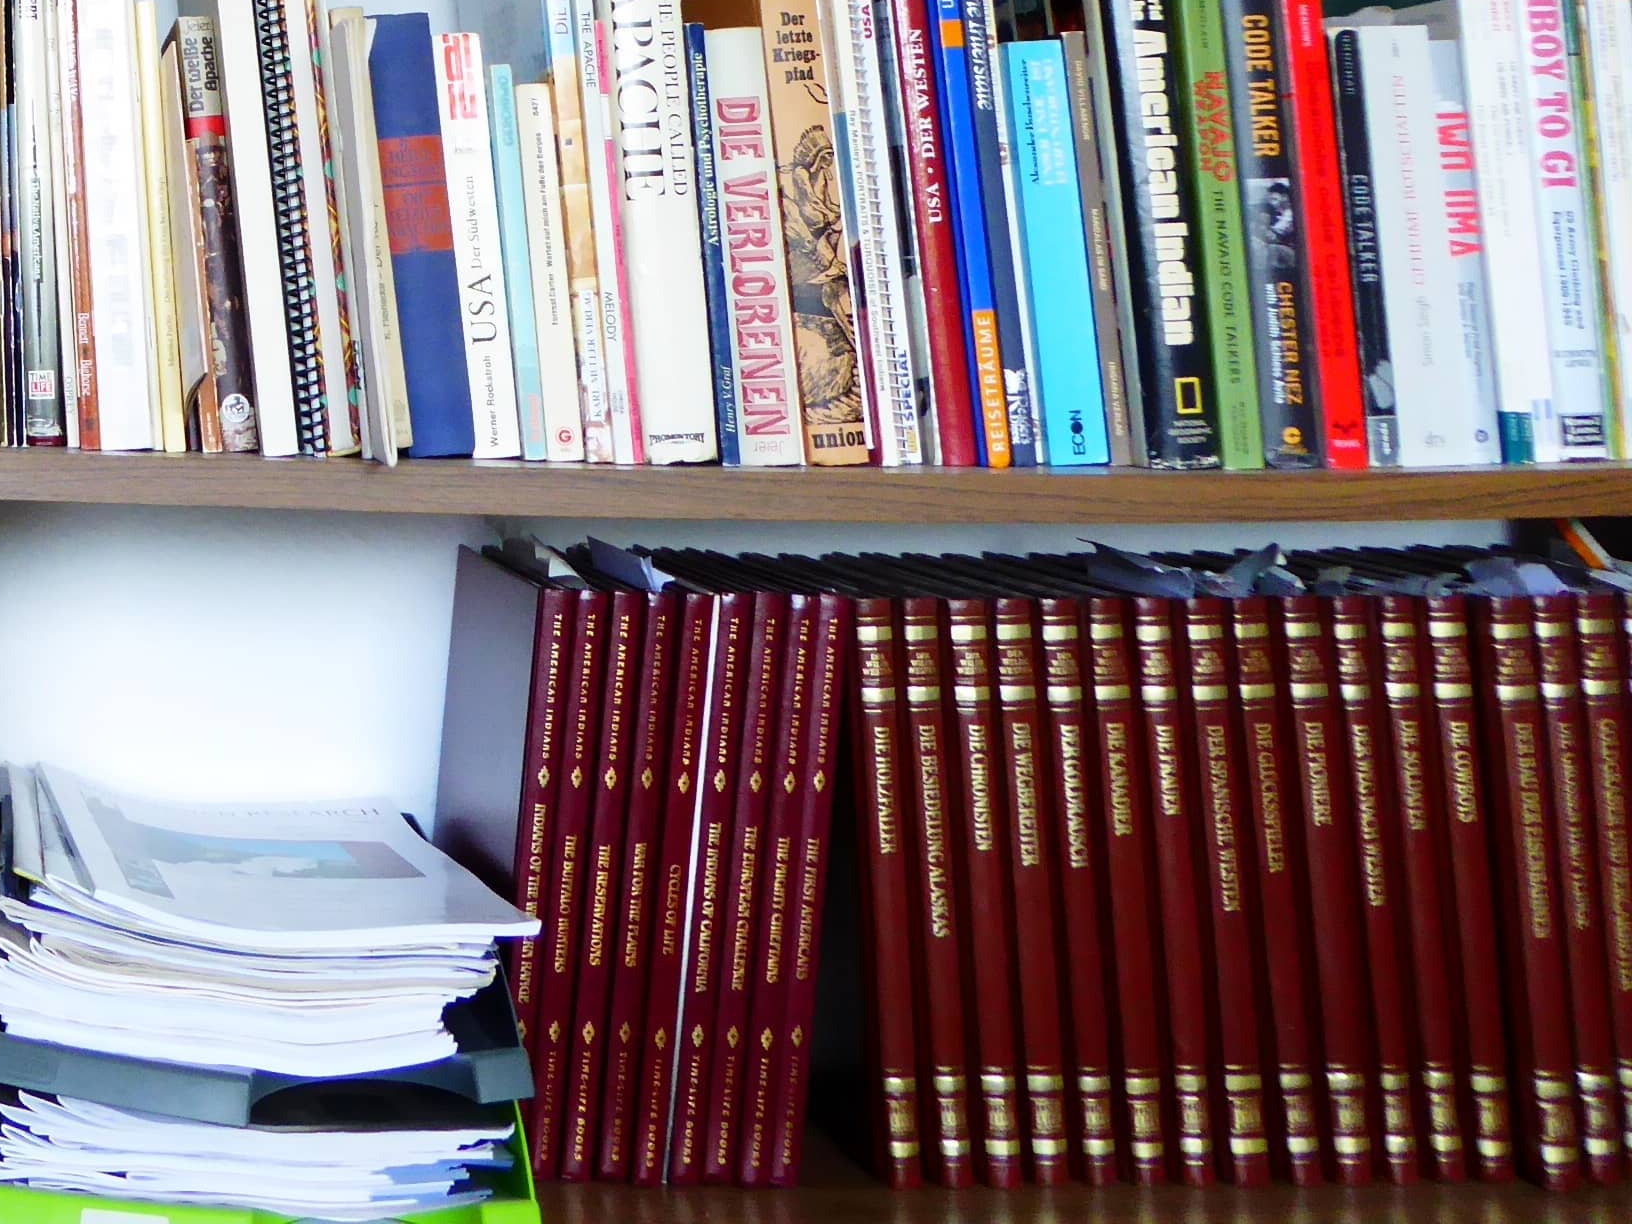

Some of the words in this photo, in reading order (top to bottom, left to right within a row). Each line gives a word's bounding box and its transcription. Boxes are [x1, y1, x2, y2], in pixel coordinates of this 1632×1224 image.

[552, 7, 568, 36] DIE
[1240, 14, 1269, 72] CODE
[197, 36, 217, 91] Apache
[187, 85, 205, 112] Der
[690, 52, 711, 148] Psychotherapie
[717, 96, 762, 158] DIE
[1133, 28, 1186, 220] American
[1248, 79, 1280, 157] TALKER
[1534, 89, 1572, 139] TO
[699, 152, 712, 176] und
[1542, 149, 1577, 188] GI
[702, 180, 719, 247] Astrologie
[720, 170, 789, 435] VERLORENEN
[1156, 222, 1196, 346] Indian
